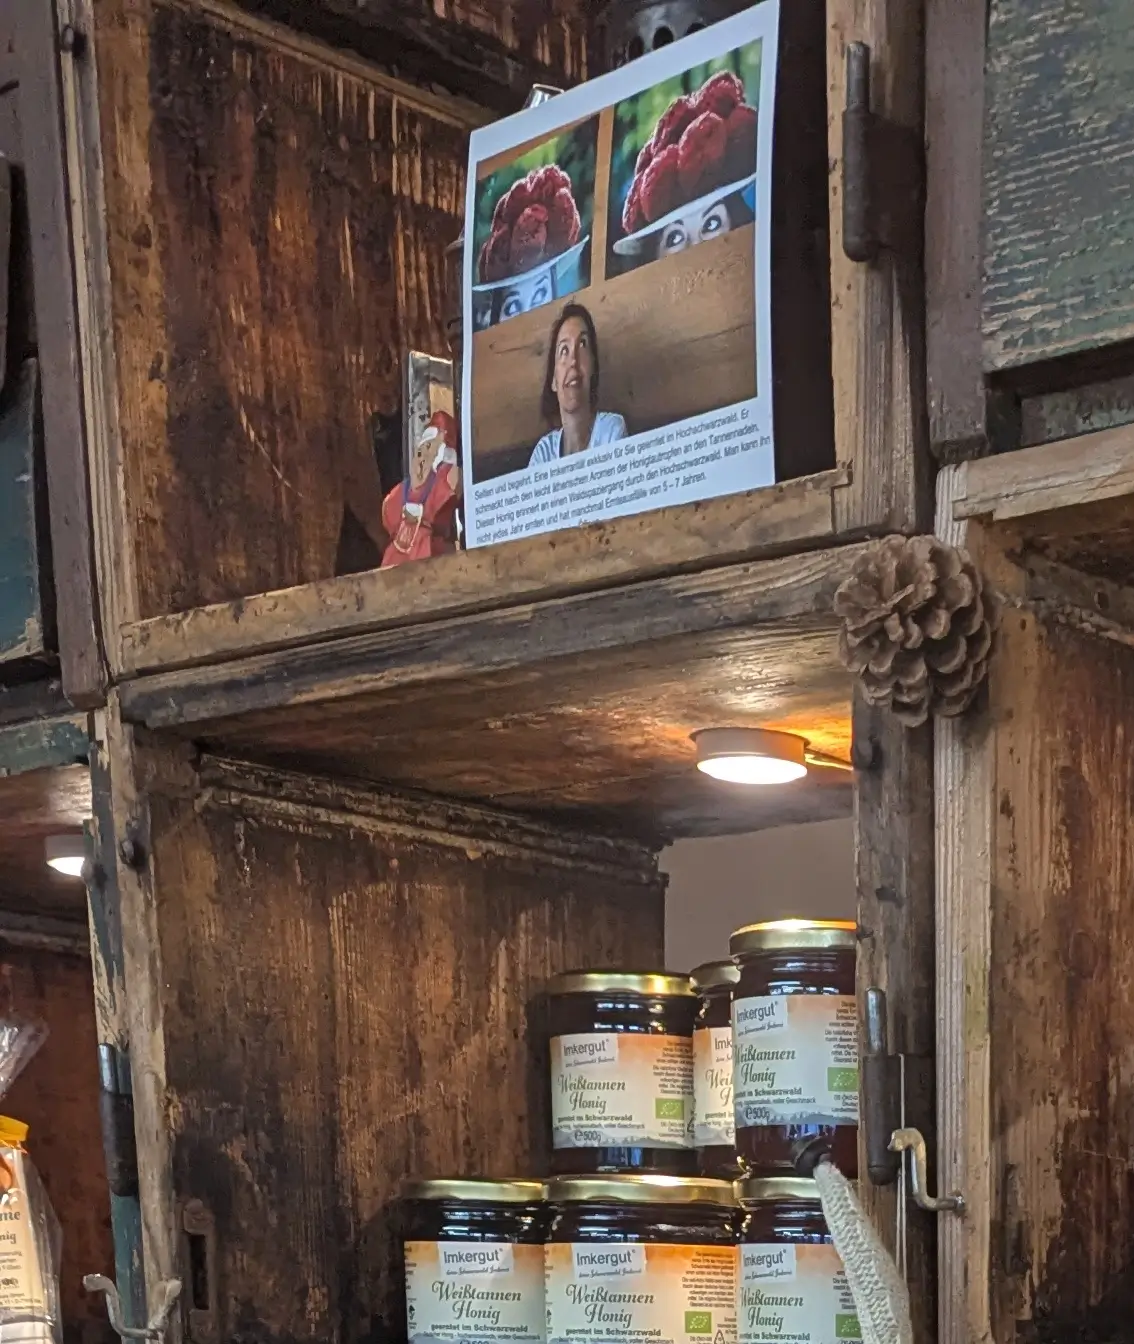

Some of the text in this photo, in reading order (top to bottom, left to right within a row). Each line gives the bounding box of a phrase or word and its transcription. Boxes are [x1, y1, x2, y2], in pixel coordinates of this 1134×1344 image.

[495, 484, 506, 494] und
[534, 471, 548, 482] Eine
[614, 447, 623, 457] für
[741, 408, 749, 419] Er
[694, 439, 707, 450] den
[496, 512, 514, 523] Honig
[452, 1300, 501, 1326] Honig
[584, 1303, 633, 1329] Honig
[748, 1307, 783, 1332] Honig
